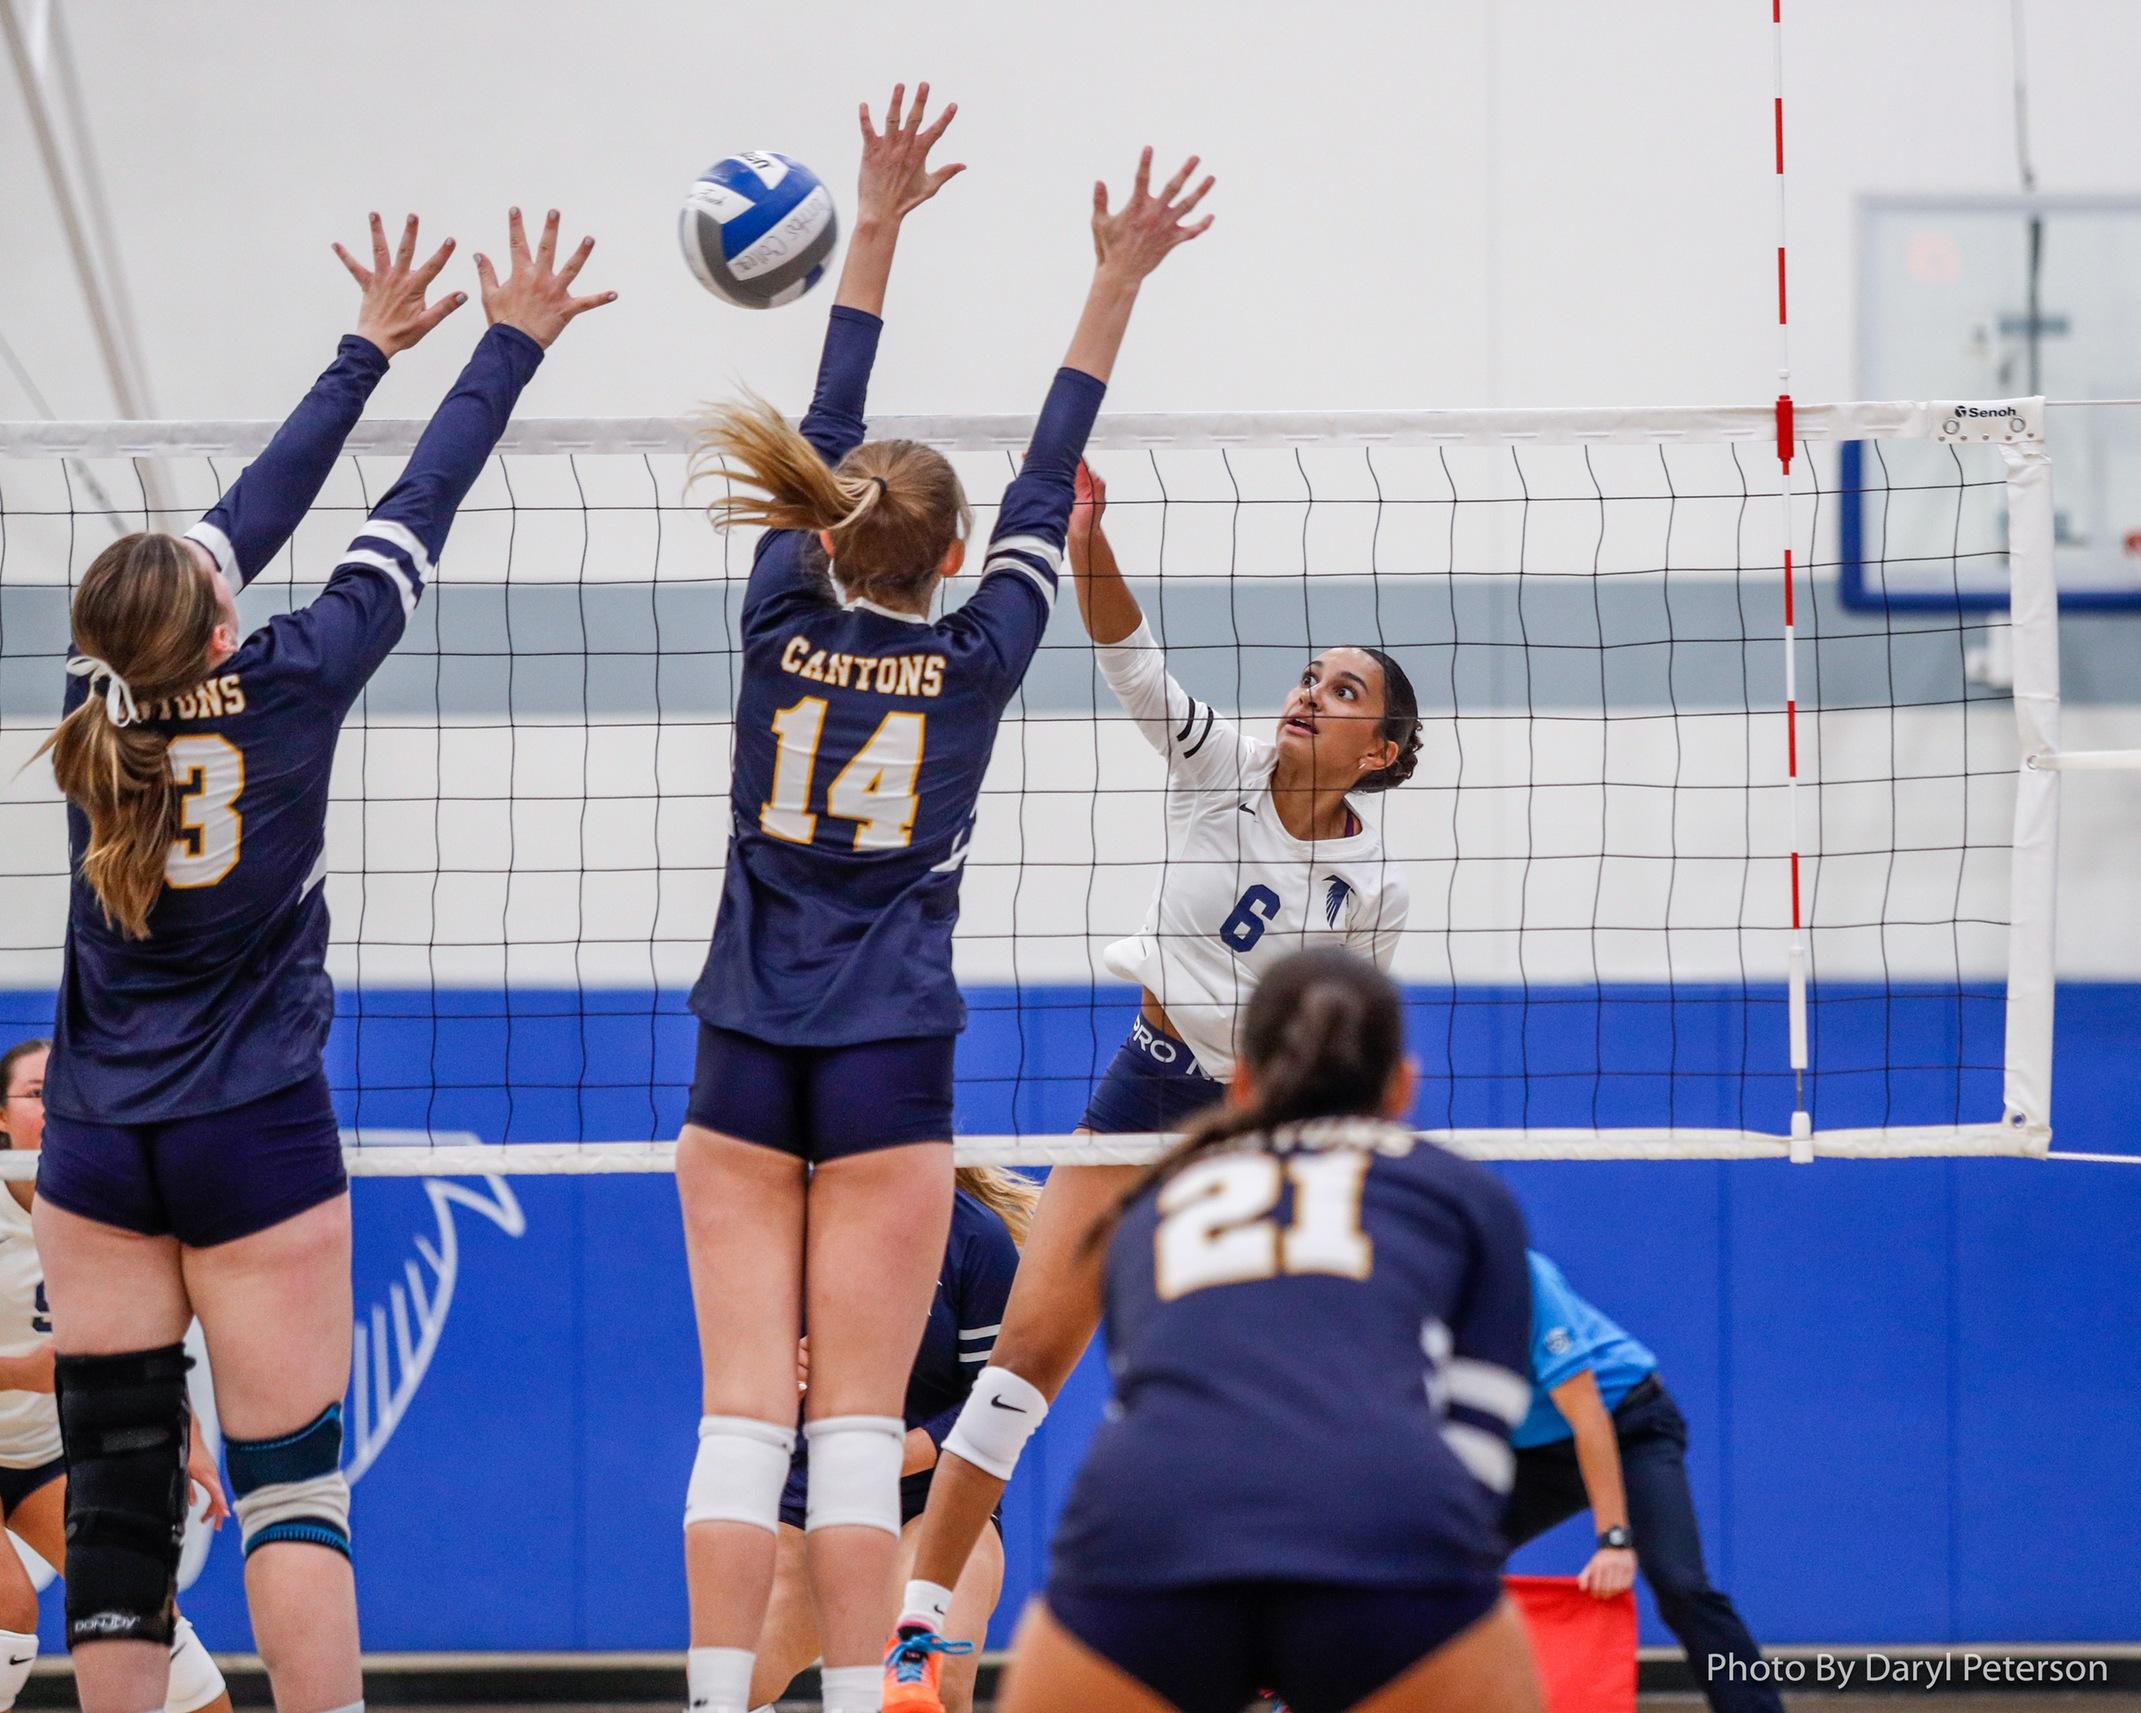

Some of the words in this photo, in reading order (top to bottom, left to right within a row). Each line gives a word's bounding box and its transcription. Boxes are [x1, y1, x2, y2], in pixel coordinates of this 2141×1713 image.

[1968, 406, 2016, 418] Senoh
[780, 635, 947, 697] CANYONS
[163, 733, 246, 889] 3
[759, 695, 926, 851] 14
[1219, 883, 1281, 953] 6
[1154, 1149, 1373, 1302] 21
